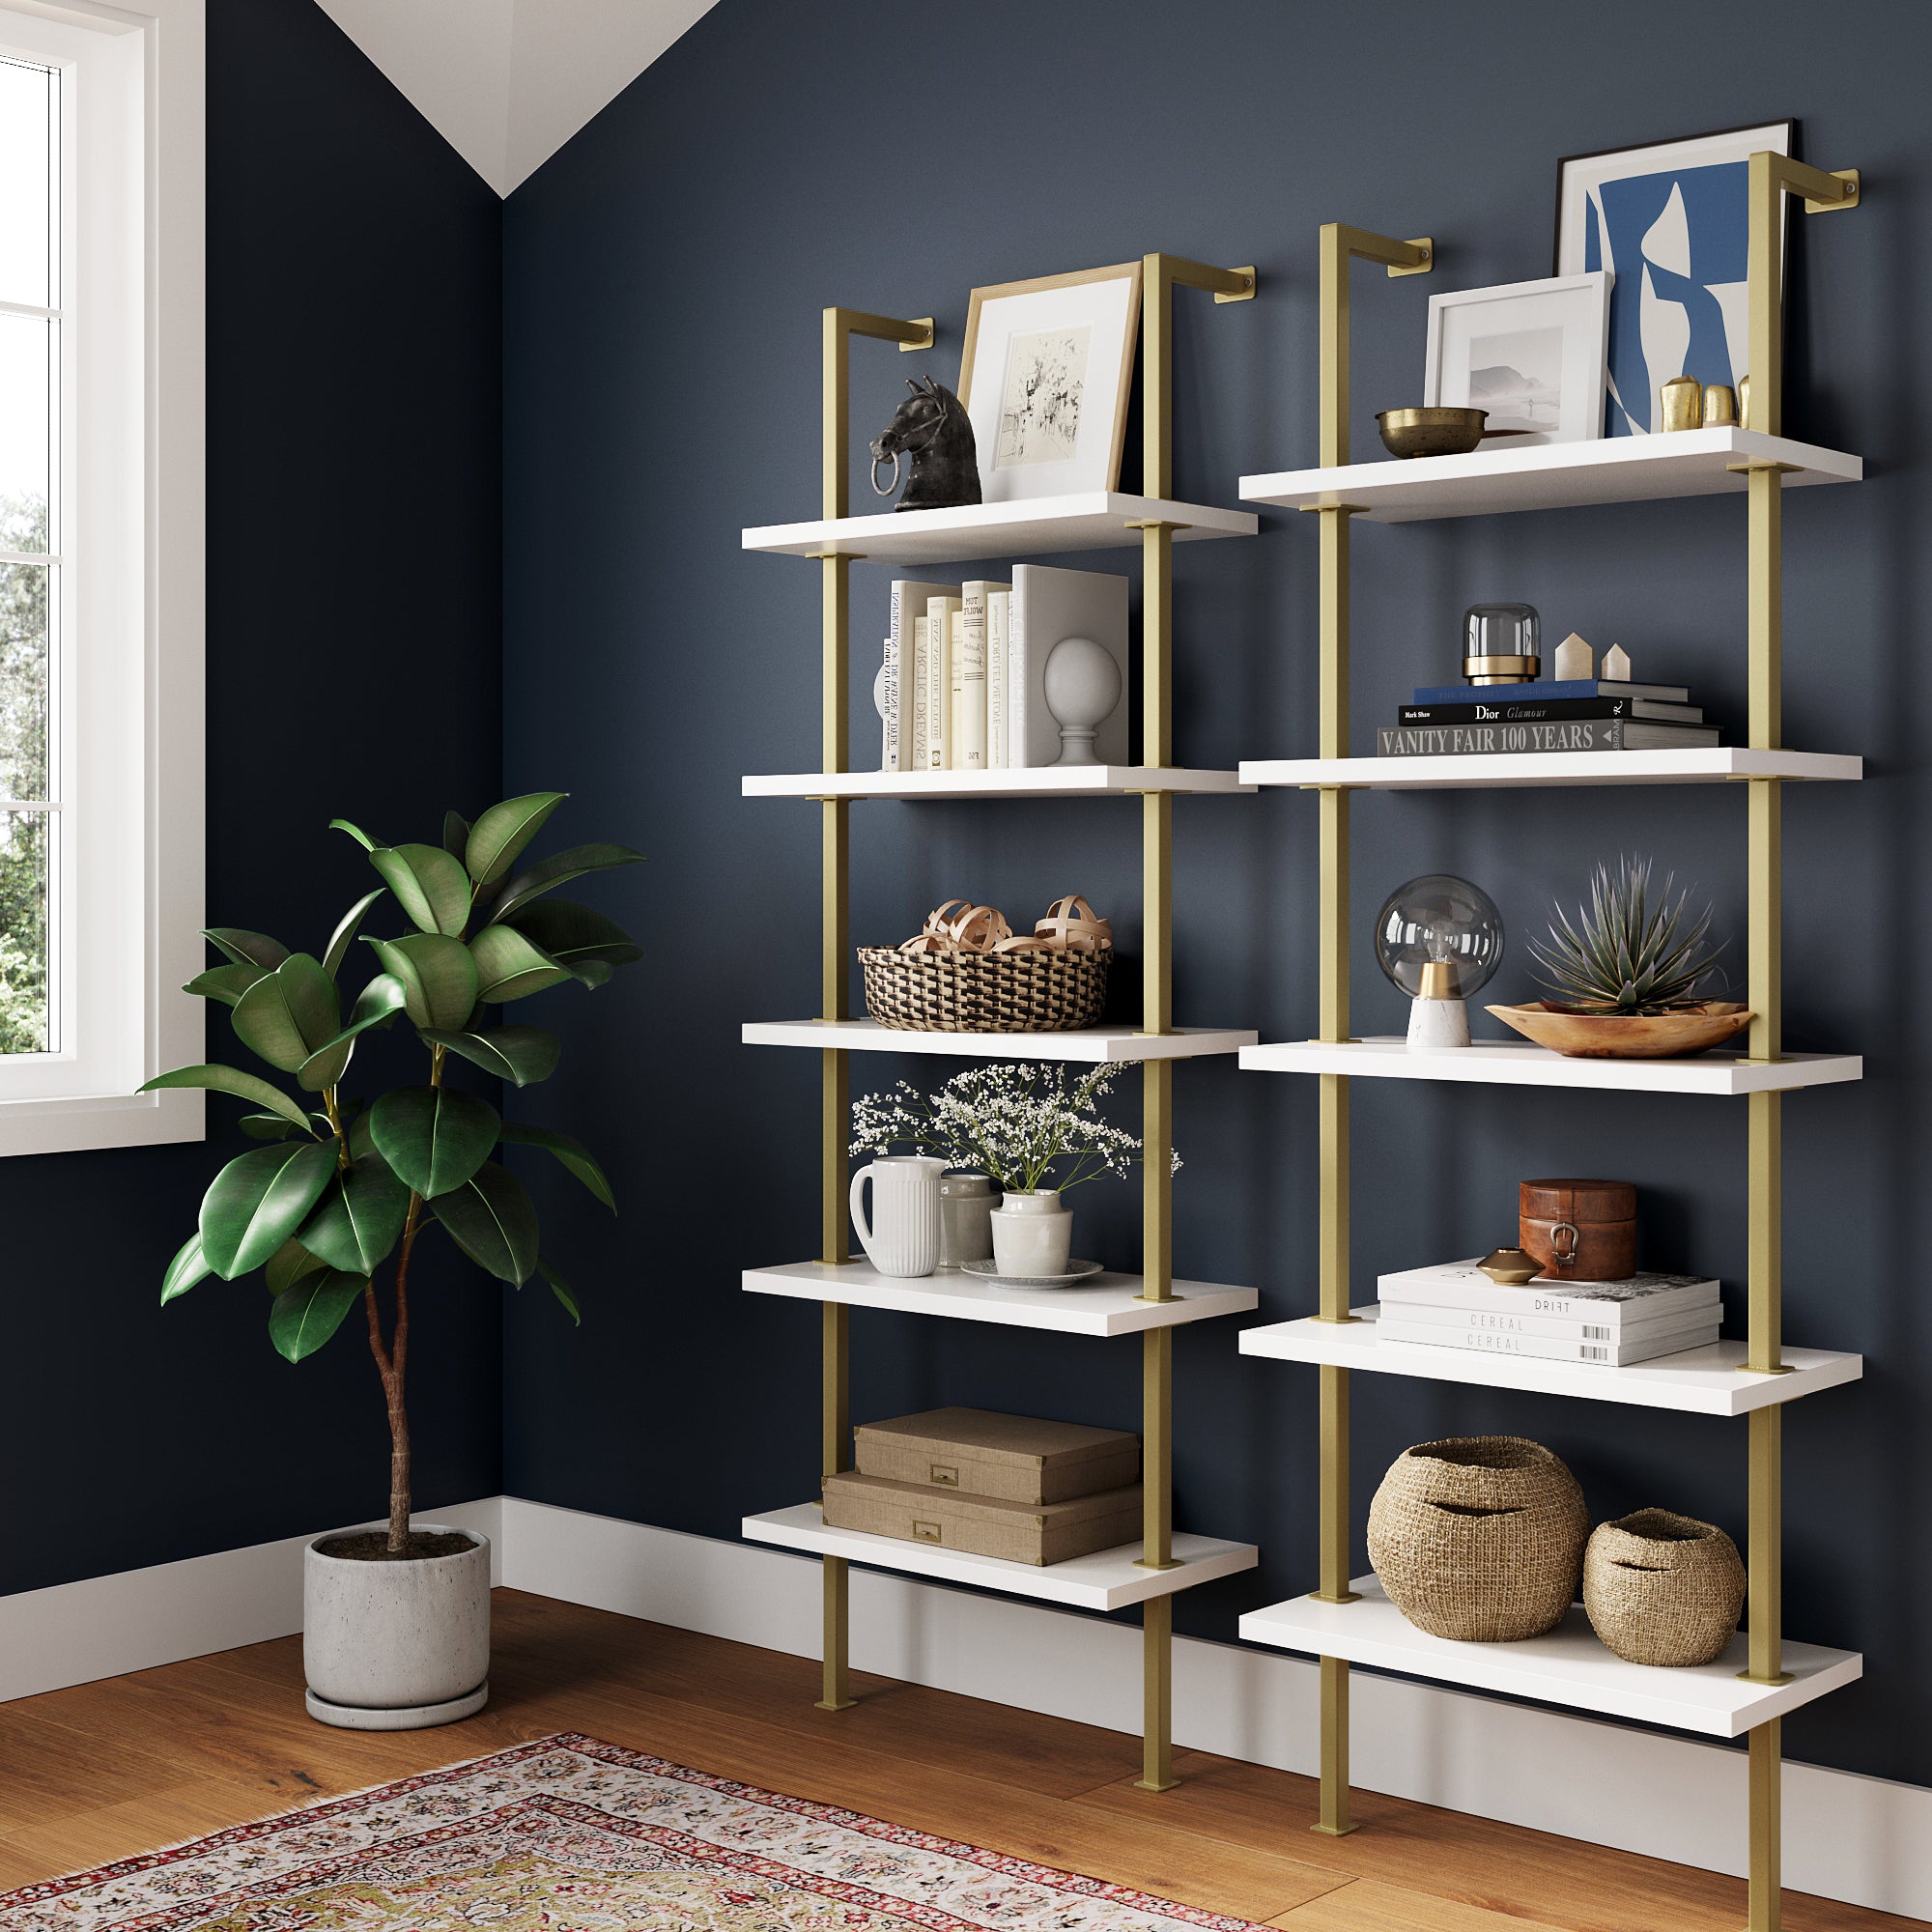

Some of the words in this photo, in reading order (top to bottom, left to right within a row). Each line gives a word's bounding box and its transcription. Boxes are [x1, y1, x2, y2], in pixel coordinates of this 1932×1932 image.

[1475, 705, 1500, 720] Dior
[1507, 706, 1546, 719] Glamour
[1382, 729, 1448, 754] VANITY
[1453, 727, 1495, 753] FAIR
[1500, 726, 1527, 752] 100
[1531, 724, 1593, 750] YEARS
[1470, 1314, 1523, 1330] CEREAL
[1467, 1334, 1520, 1350] CEREAL
